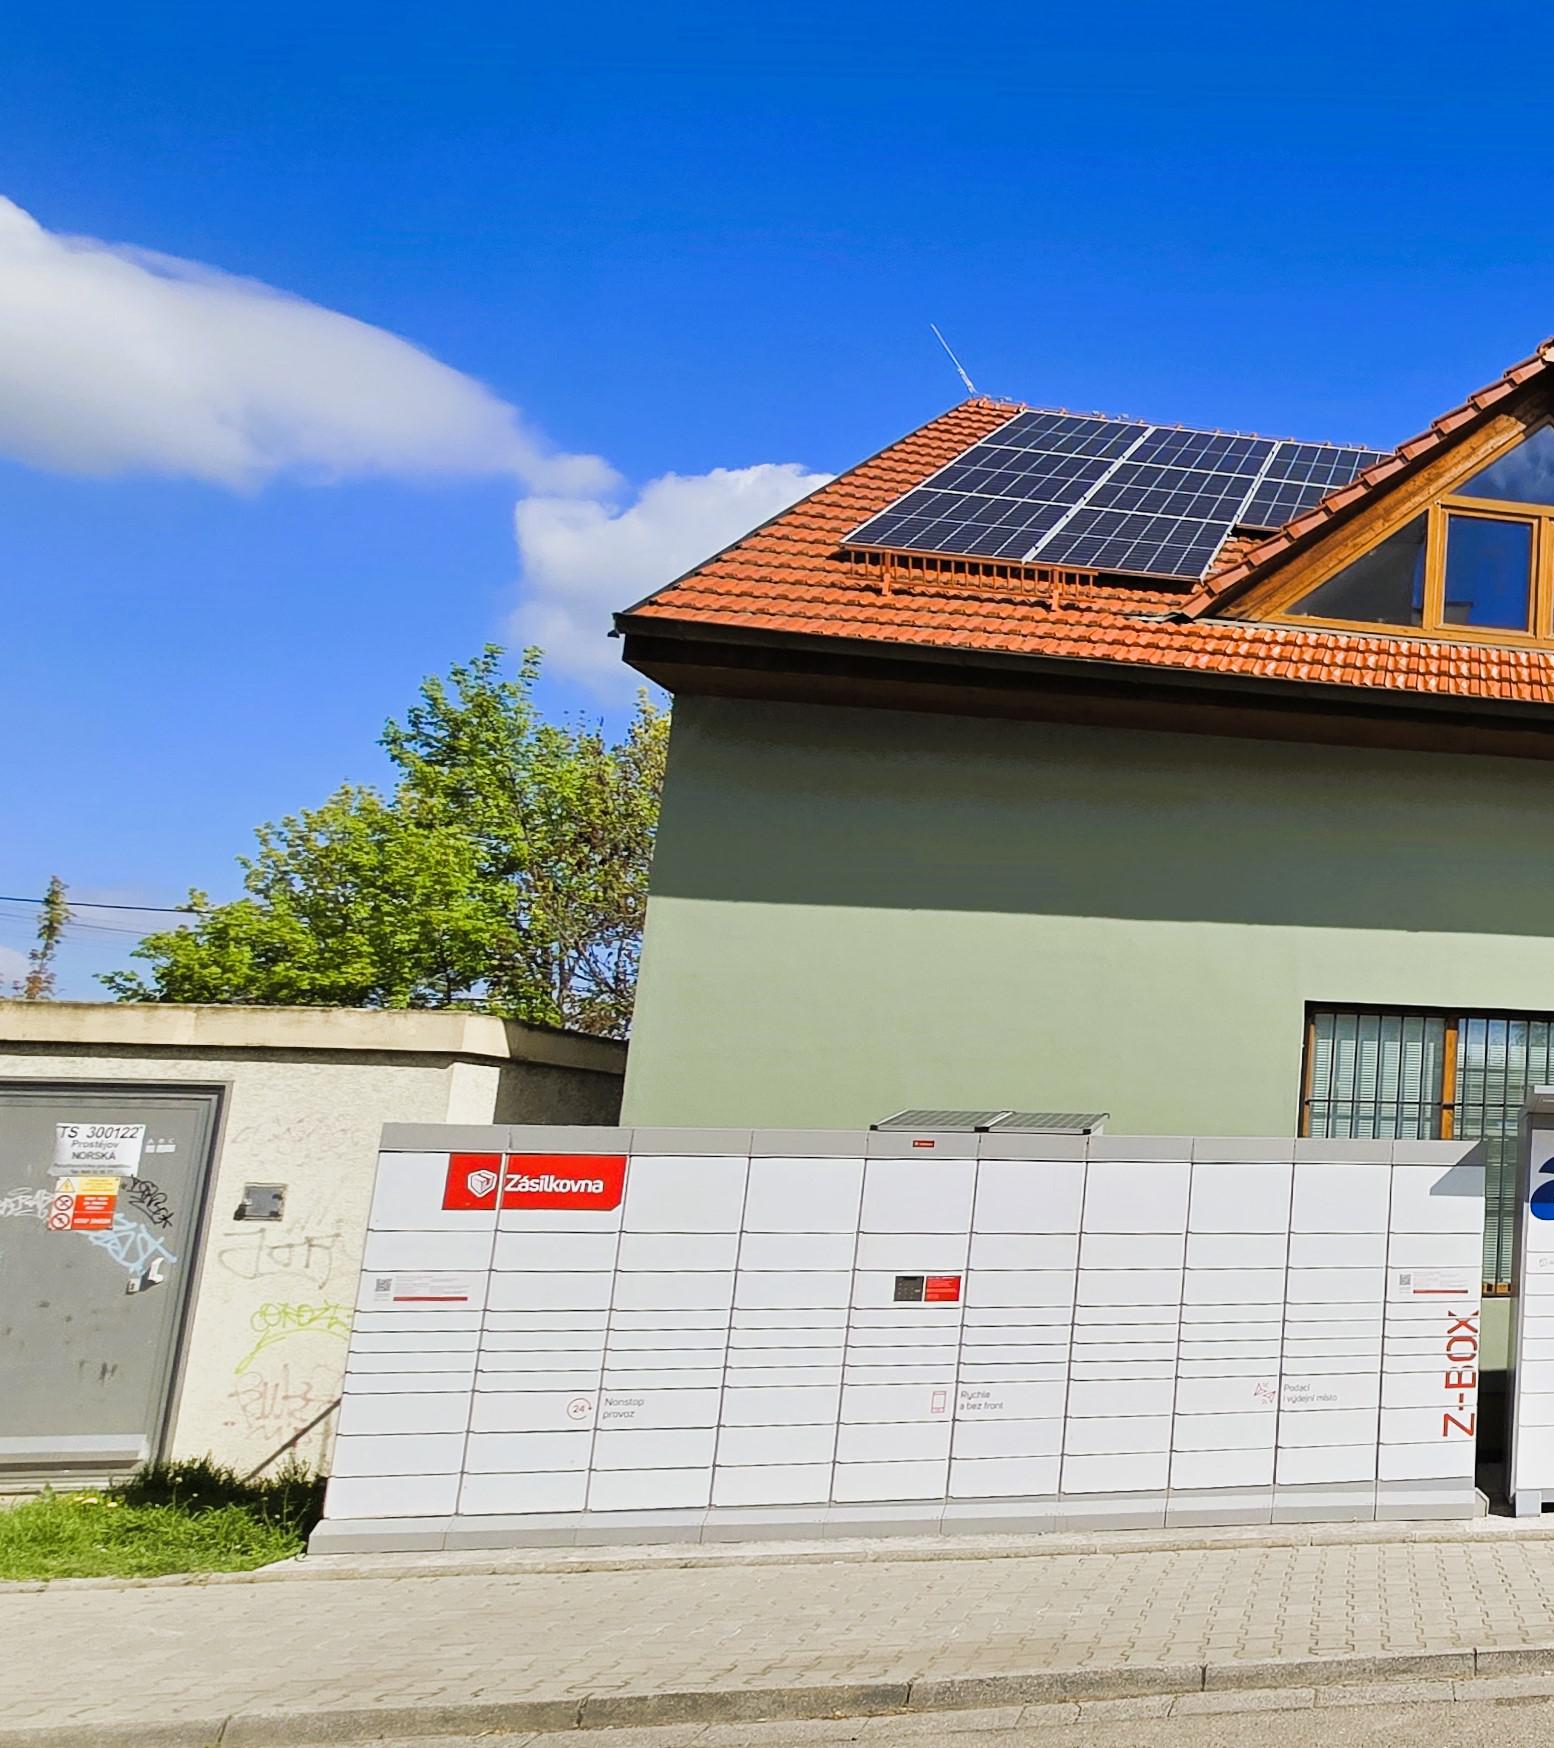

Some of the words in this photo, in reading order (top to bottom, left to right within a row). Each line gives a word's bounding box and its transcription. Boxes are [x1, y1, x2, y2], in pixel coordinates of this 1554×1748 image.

[60, 1126, 80, 1138] TS
[86, 1126, 140, 1139] 300122
[505, 1174, 603, 1193] Zásilkovna
[1443, 1310, 1479, 1437] Z-BOX
[605, 1398, 645, 1407] Nonstop
[602, 1411, 635, 1419] provoz
